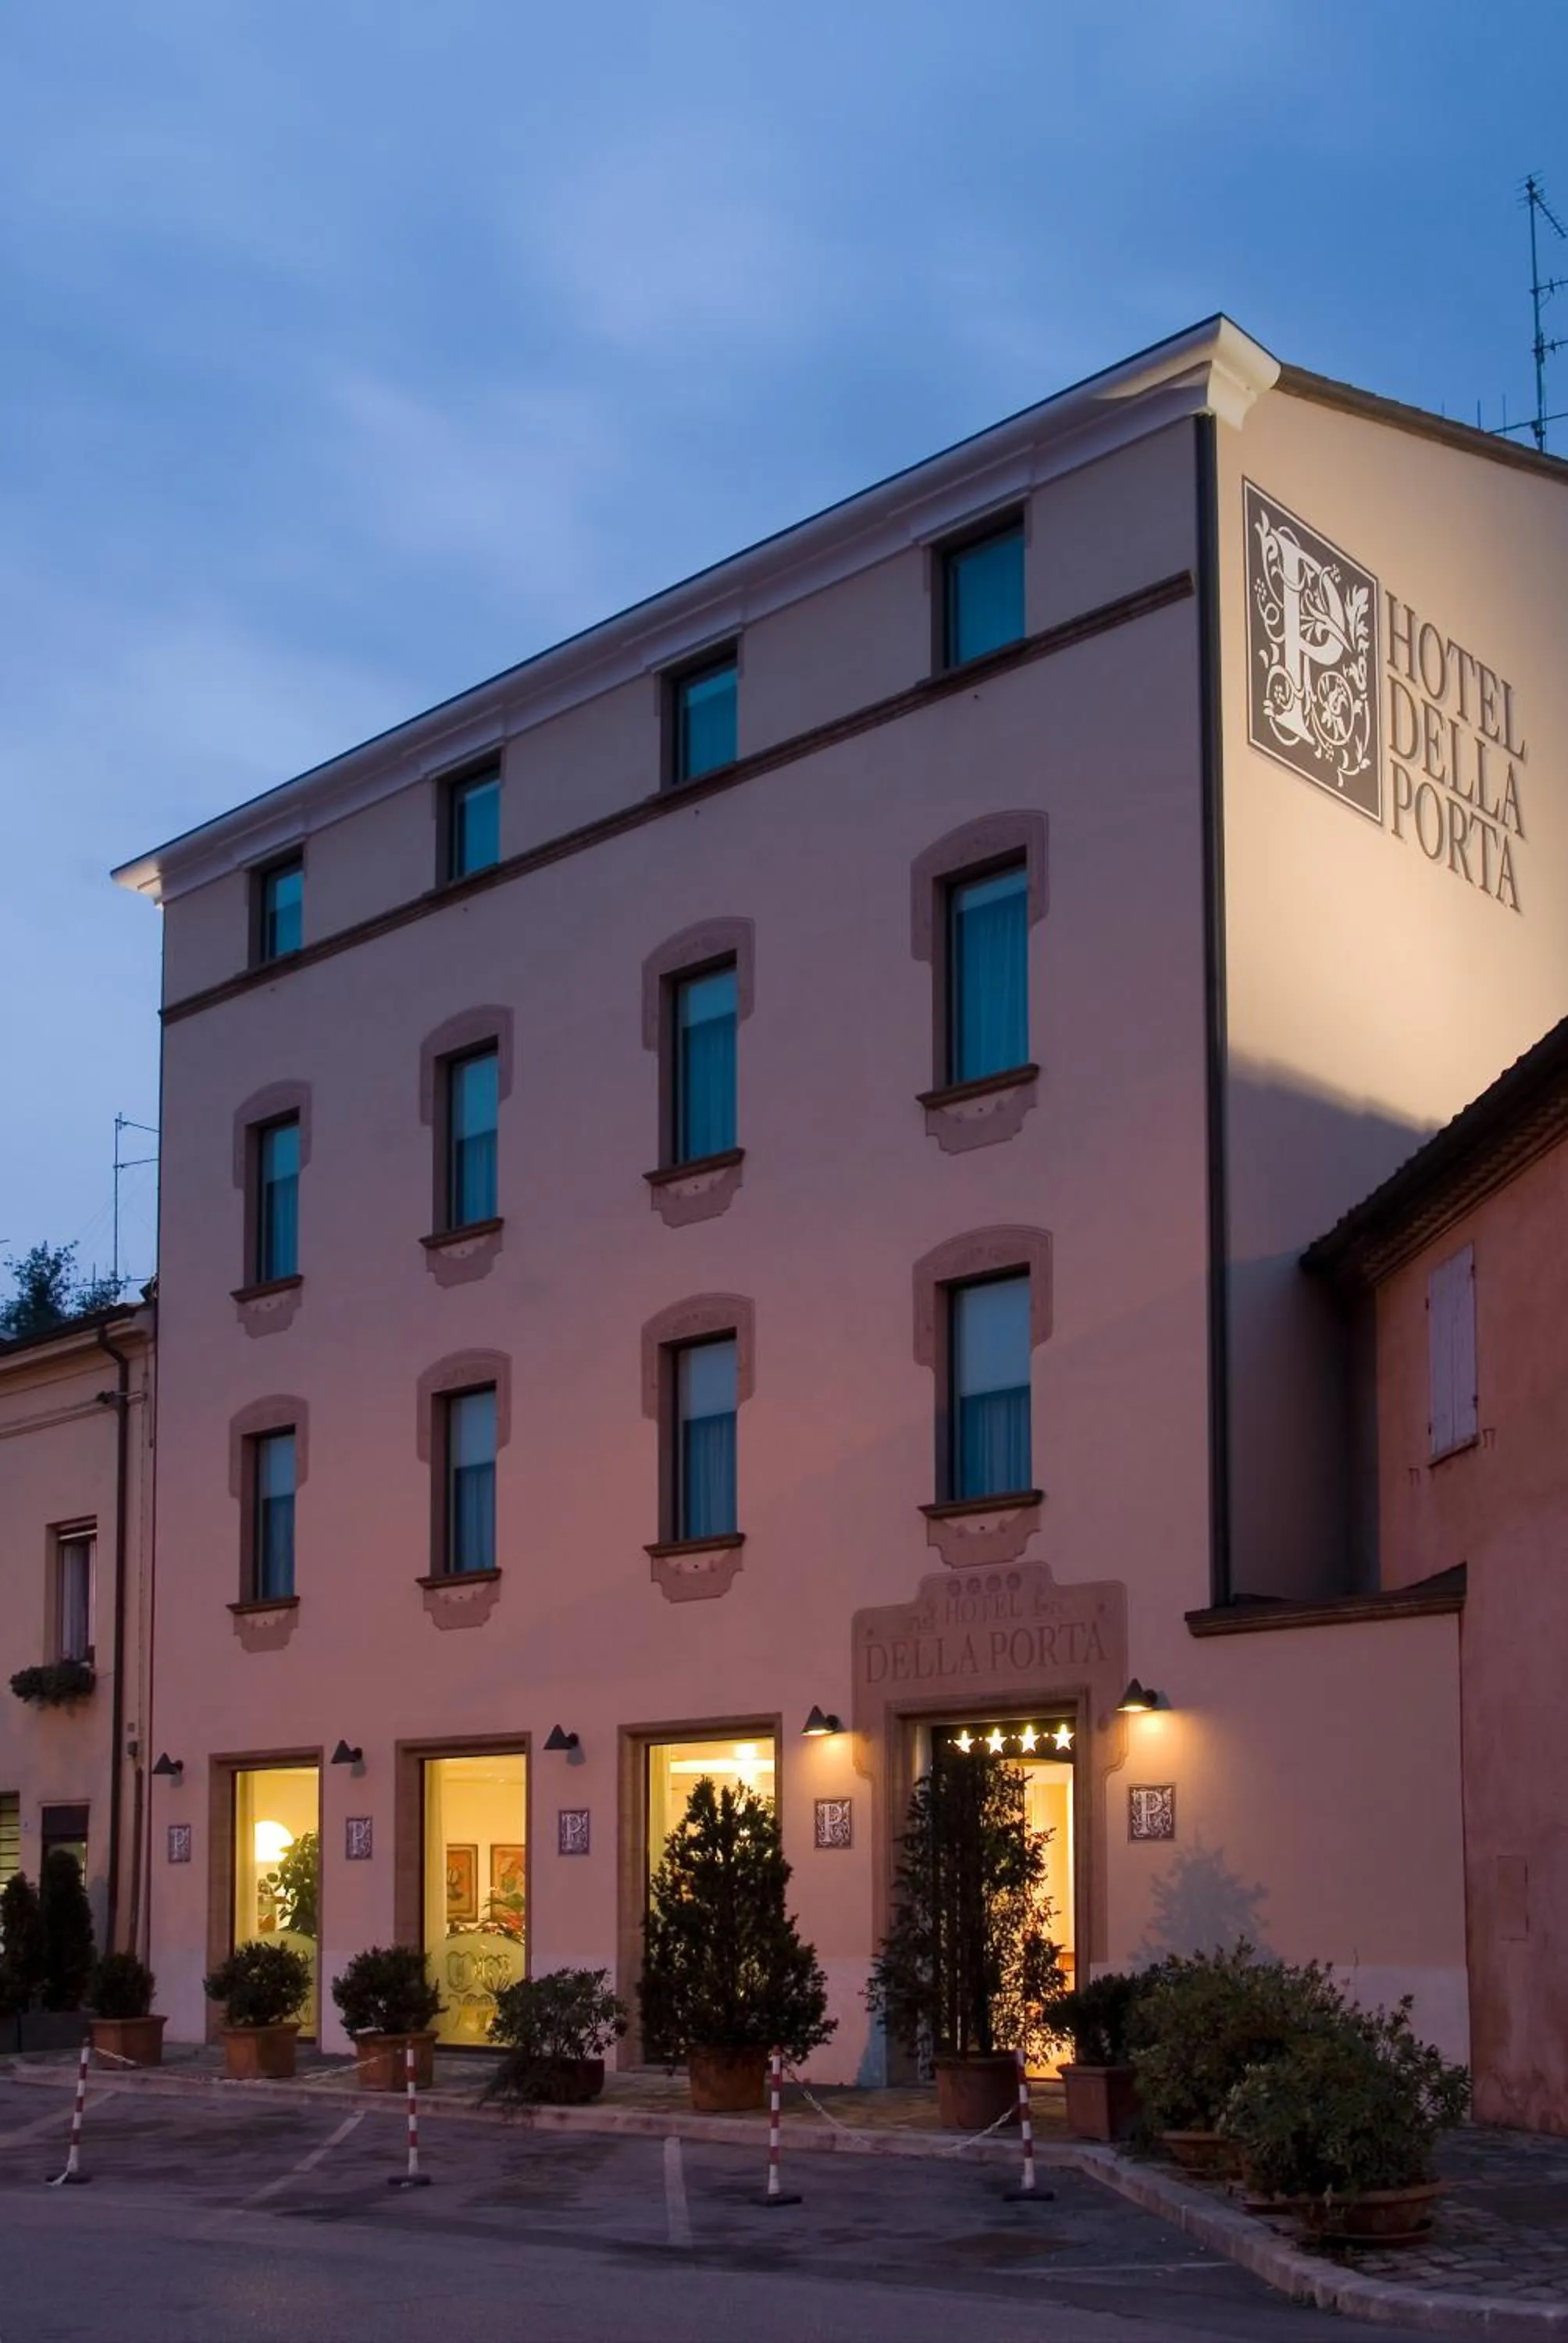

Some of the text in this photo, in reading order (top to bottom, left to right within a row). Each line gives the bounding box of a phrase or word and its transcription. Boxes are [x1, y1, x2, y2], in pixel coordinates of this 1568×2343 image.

[1385, 590, 1526, 761] HOTEL
[1388, 674, 1524, 839] DELLA
[1390, 758, 1521, 912] PORTA
[863, 1620, 1111, 1684] DELLA PORTA
[946, 1591, 1025, 1625] HOTEL
